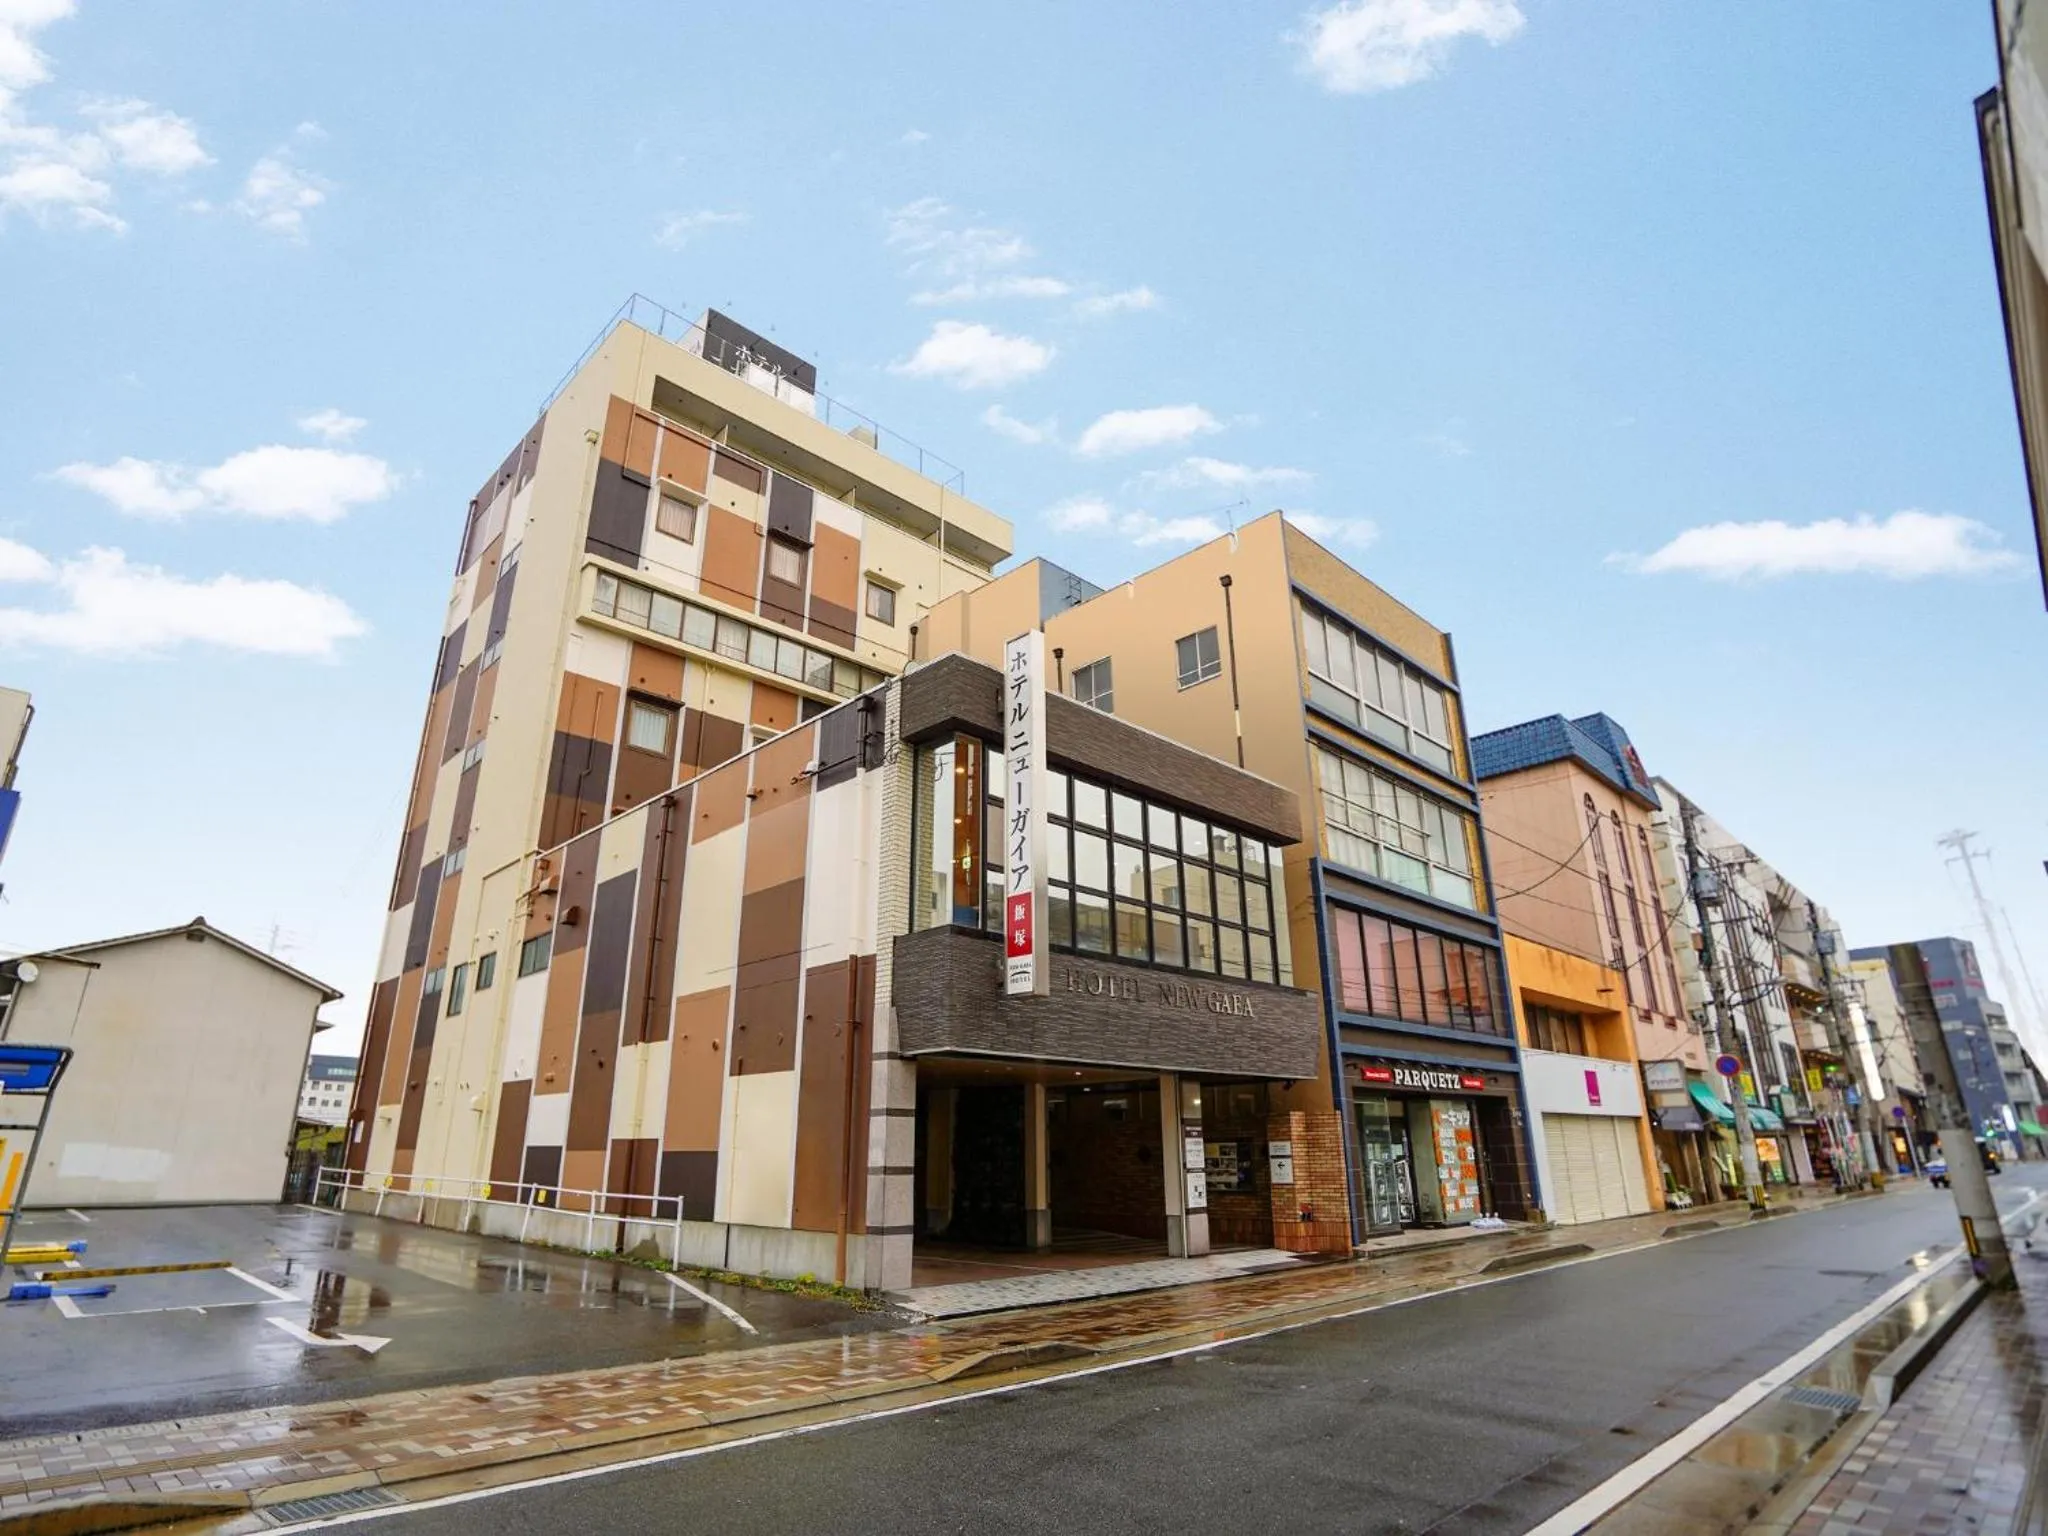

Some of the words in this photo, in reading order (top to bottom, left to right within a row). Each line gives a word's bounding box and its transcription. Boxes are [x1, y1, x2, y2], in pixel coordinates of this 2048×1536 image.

[1010, 651, 1030, 890] ホテルニューガイア
[1066, 968, 1146, 1002] HOTEL
[1159, 982, 1204, 1010] NEW
[1207, 991, 1255, 1018] GAEA
[1393, 1068, 1460, 1090] PARQUETZ
